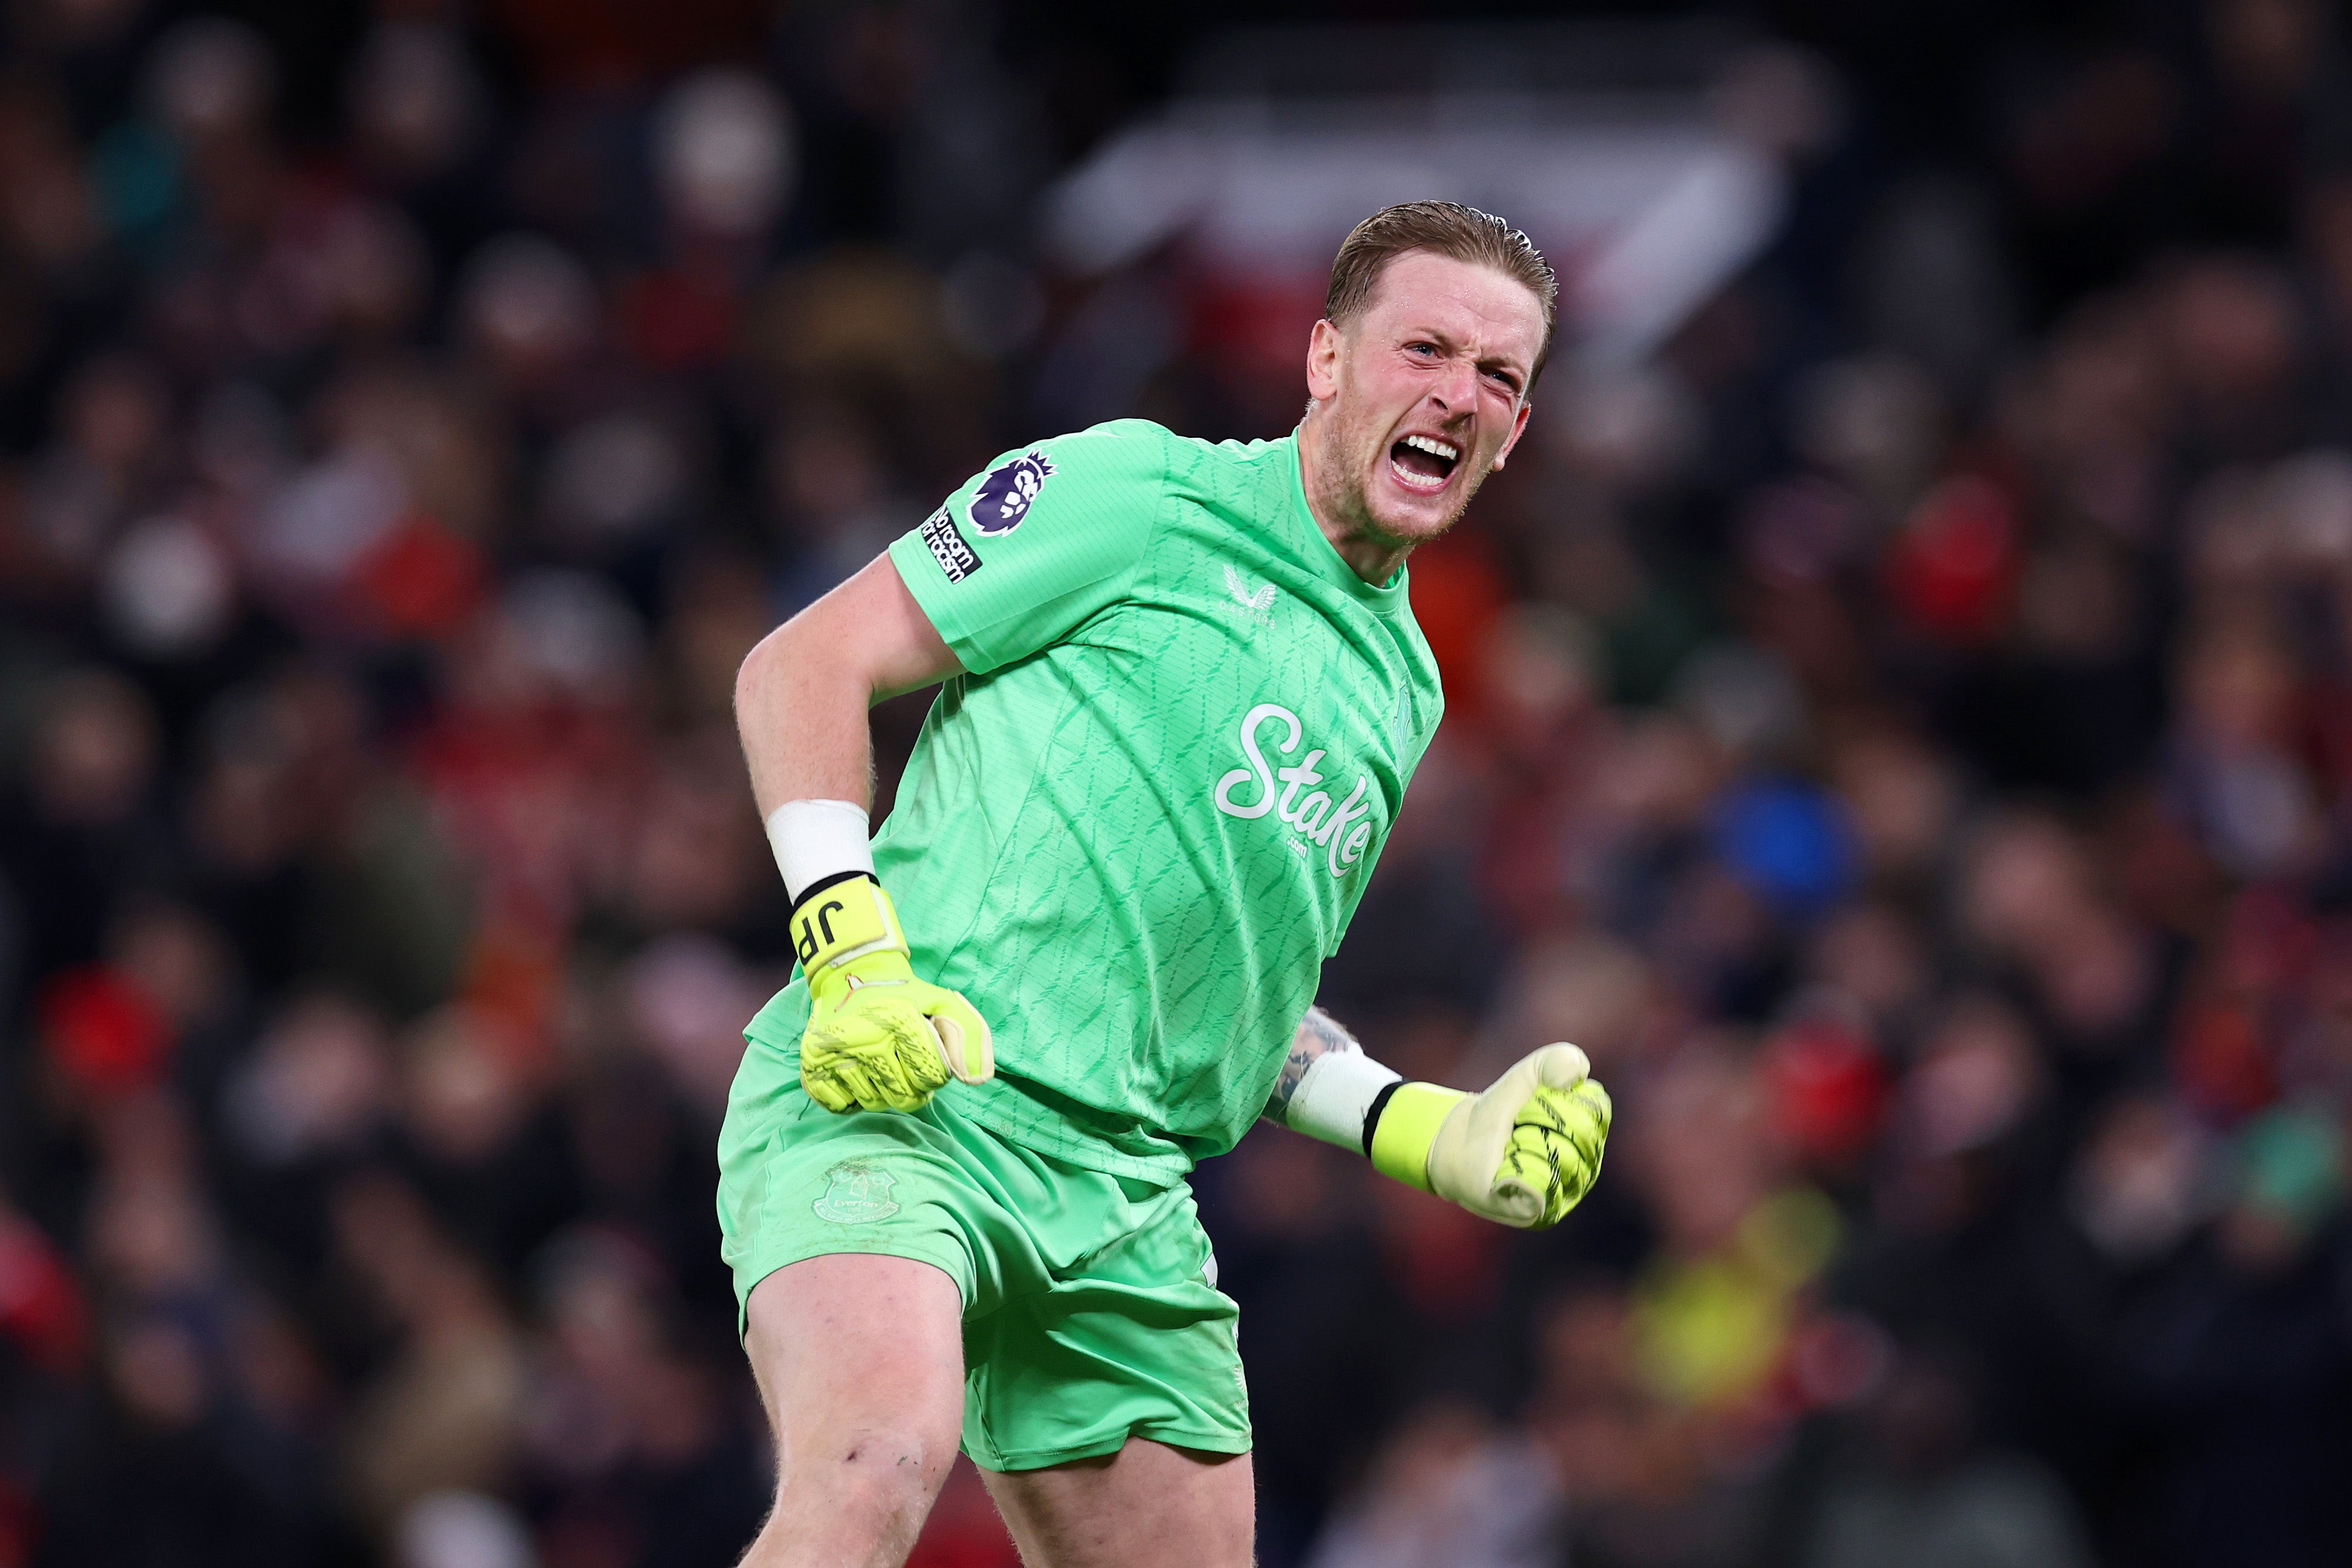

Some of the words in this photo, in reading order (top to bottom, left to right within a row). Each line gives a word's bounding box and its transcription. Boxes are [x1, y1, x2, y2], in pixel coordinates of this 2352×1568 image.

[935, 504, 949, 528] No
[926, 532, 964, 584] racism
[939, 524, 974, 569] room
[1219, 600, 1276, 629] CASTORE
[1214, 703, 1371, 877] Stake
[1286, 835, 1308, 859] .com
[798, 900, 844, 966] JP
[834, 1198, 879, 1208] Everton
